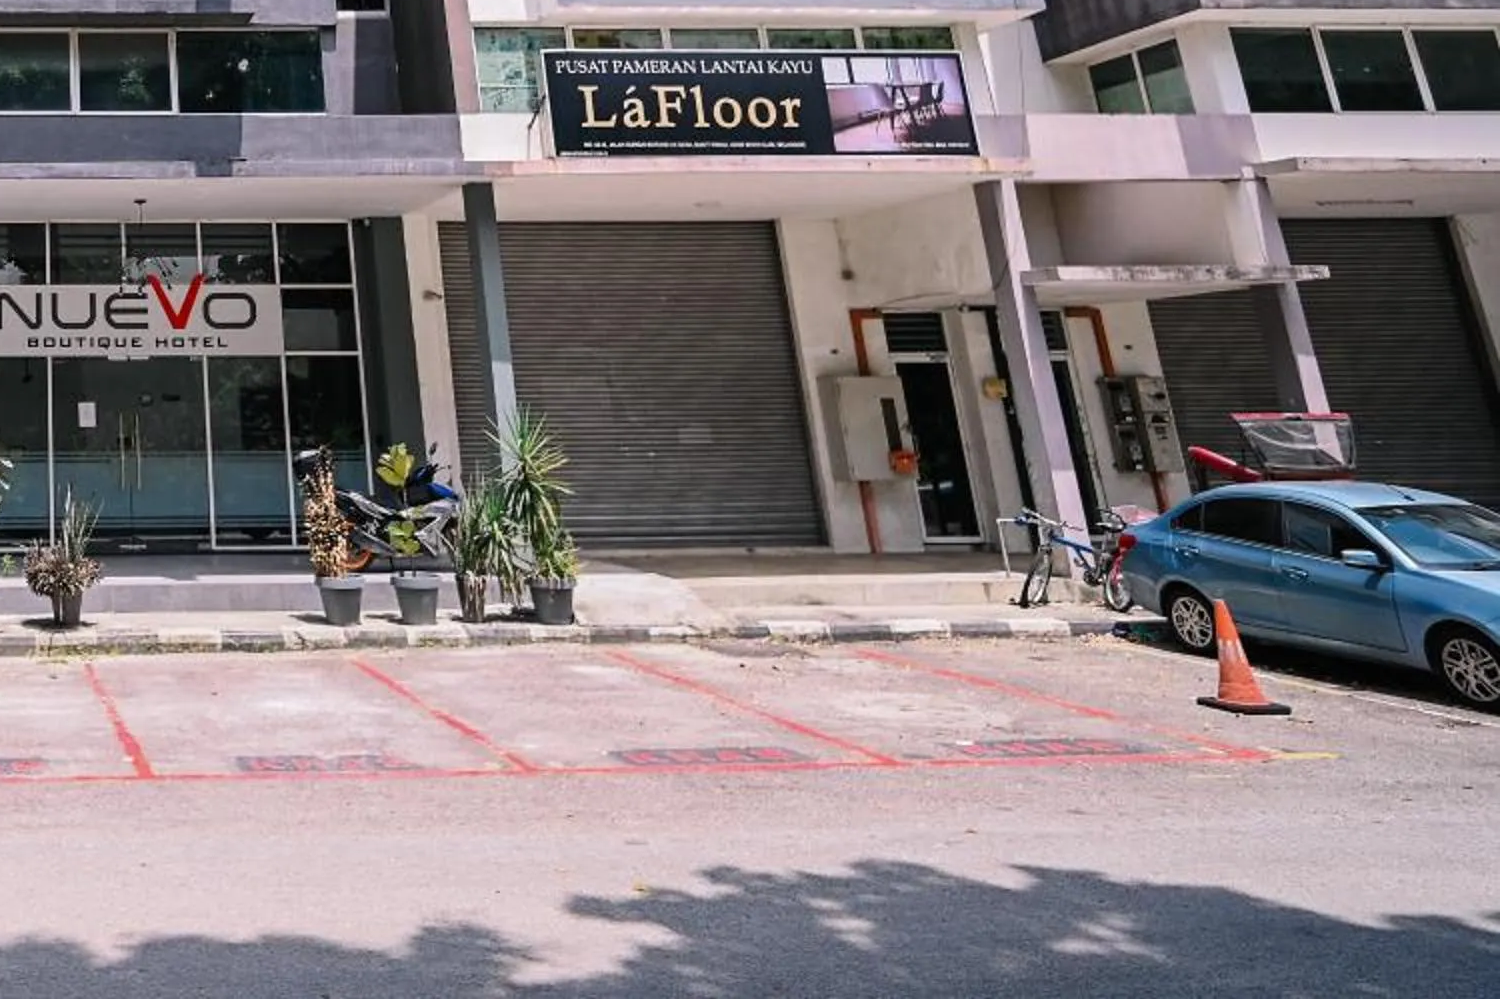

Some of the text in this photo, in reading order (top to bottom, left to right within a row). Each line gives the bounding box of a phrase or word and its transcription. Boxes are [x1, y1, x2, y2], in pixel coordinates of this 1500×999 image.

[555, 59, 814, 75] PUSAT PAMERAN LANTAI KAYU
[577, 84, 802, 130] LáFloor
[27, 336, 229, 351] BOUTIQUE HOTEL
